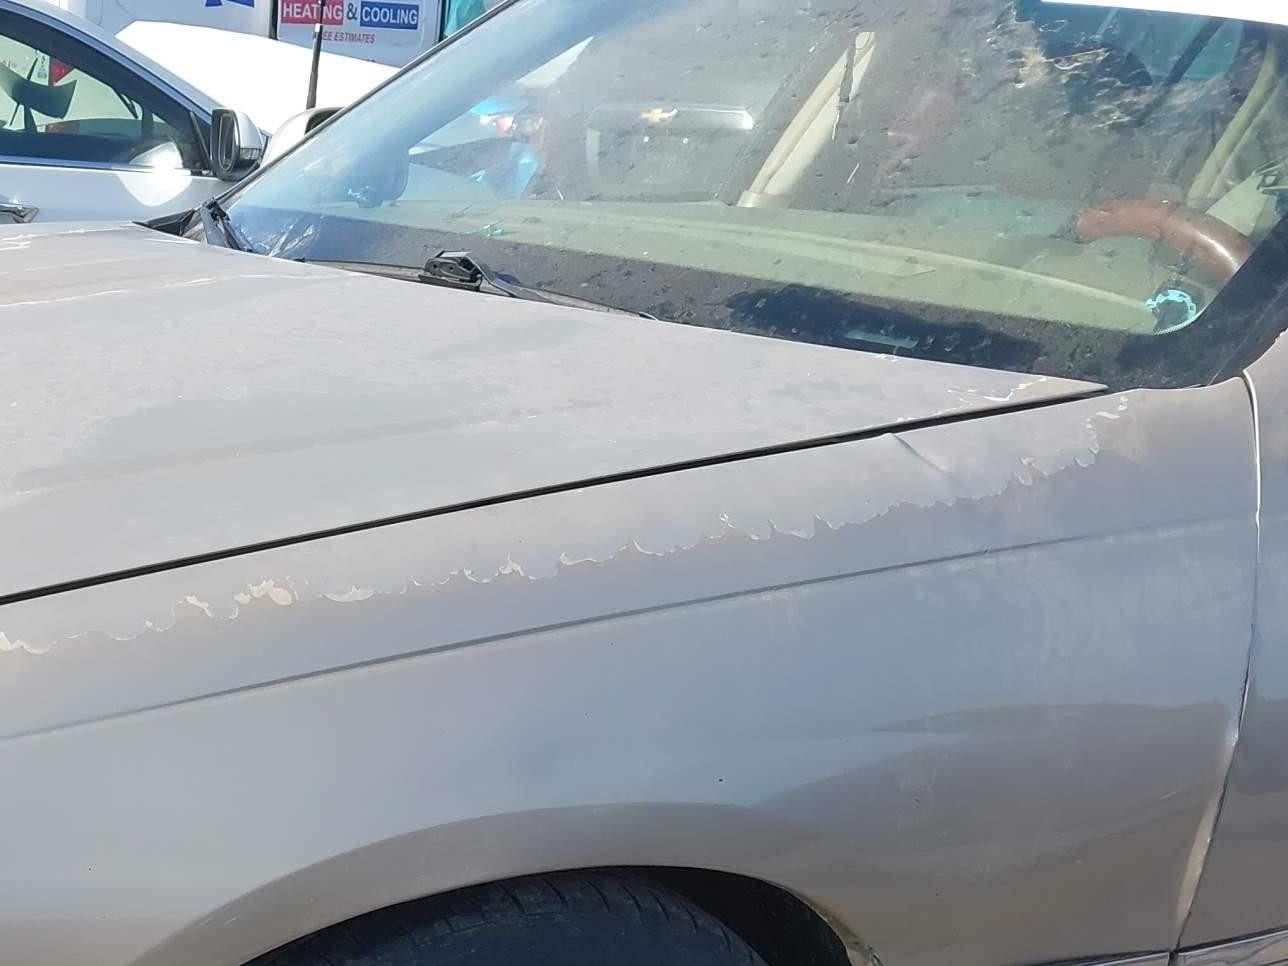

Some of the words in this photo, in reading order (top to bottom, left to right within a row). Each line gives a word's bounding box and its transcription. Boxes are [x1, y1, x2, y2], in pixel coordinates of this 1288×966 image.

[283, 2, 343, 21] HEATNG
[346, 2, 358, 21] &
[362, 6, 419, 25] COOLING
[333, 31, 376, 44] ESTIMATES
